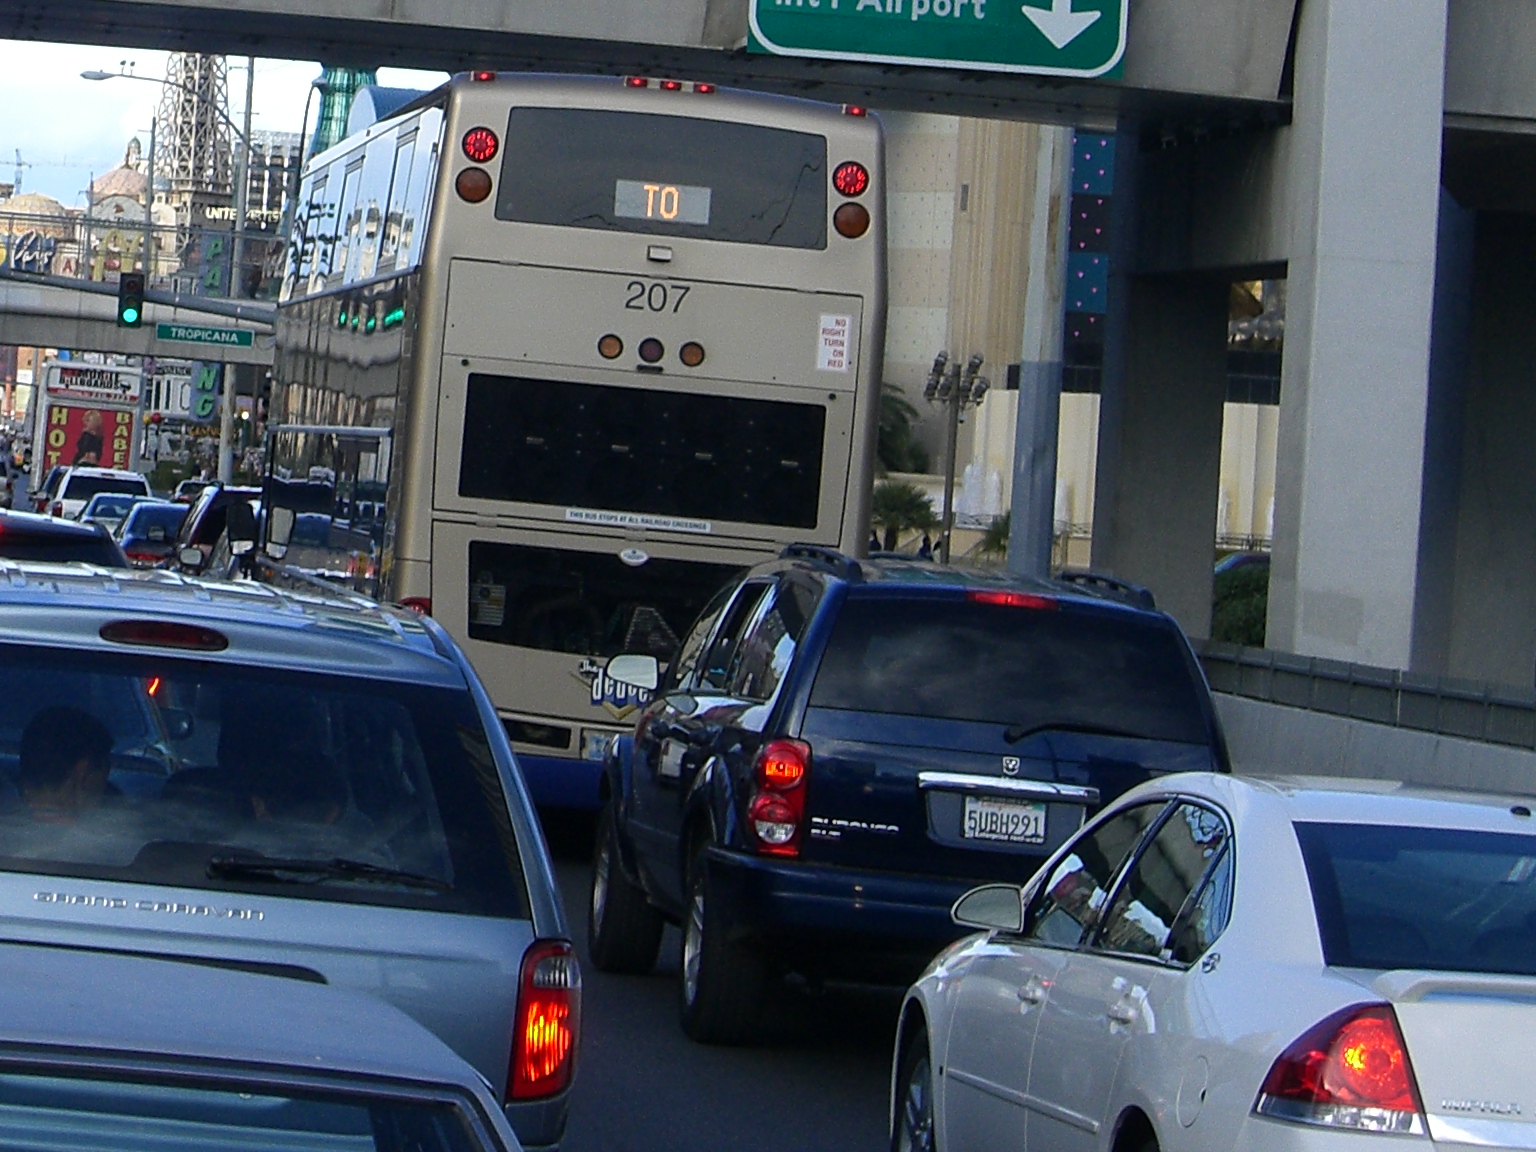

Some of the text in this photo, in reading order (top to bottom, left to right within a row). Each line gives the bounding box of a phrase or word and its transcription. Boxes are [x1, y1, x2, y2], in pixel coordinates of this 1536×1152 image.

[643, 184, 679, 219] TO
[205, 206, 238, 221] UNITE
[625, 281, 691, 314] 207
[835, 318, 847, 327] NO
[170, 327, 239, 344] TROPICANA
[822, 328, 845, 337] RIGHT
[824, 338, 845, 347] TURN
[832, 349, 844, 357] ON
[827, 359, 844, 368] RED
[968, 810, 1039, 836] 5UBH991
[34, 892, 265, 921] GRAND CARAVAN
[1442, 1099, 1521, 1115] IMPALA
